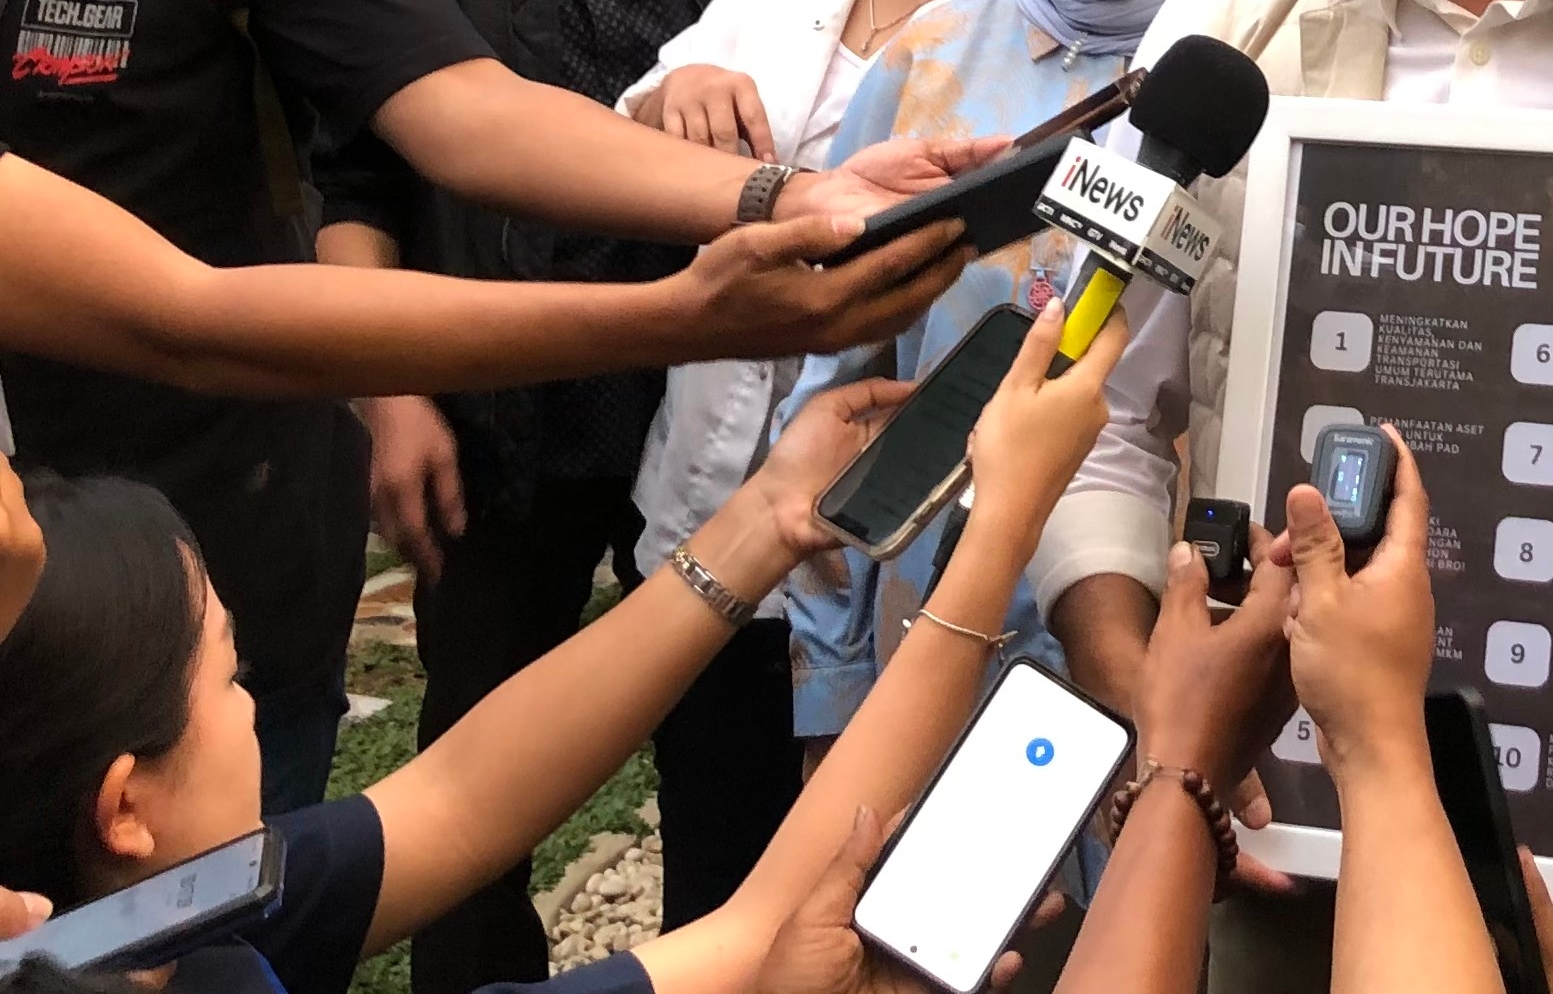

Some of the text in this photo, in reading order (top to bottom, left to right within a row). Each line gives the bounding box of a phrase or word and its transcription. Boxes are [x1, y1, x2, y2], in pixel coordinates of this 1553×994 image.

[1061, 155, 1144, 222] iNews
[1160, 204, 1210, 262] iNews
[1323, 201, 1542, 251] OUR HOPE
[1320, 238, 1540, 289] IN FUTURE
[1380, 314, 1468, 329] MENINGKATKAN
[1334, 331, 1347, 351] 1
[1458, 341, 1483, 351] DAN
[1377, 345, 1439, 358] KEAMANAN
[1536, 343, 1550, 364] 6
[1376, 355, 1460, 370] TRANSPORTASI
[1374, 374, 1460, 390] TRANSJAKARTA
[1375, 365, 1474, 382] UMUM TERUTAMA
[1406, 430, 1443, 442] UNTUK
[1456, 423, 1484, 435] ASET
[1437, 443, 1460, 454] PAD
[1530, 444, 1543, 465] 7
[1520, 542, 1533, 562] 8
[1511, 643, 1525, 664] 9
[1297, 721, 1310, 741] 5
